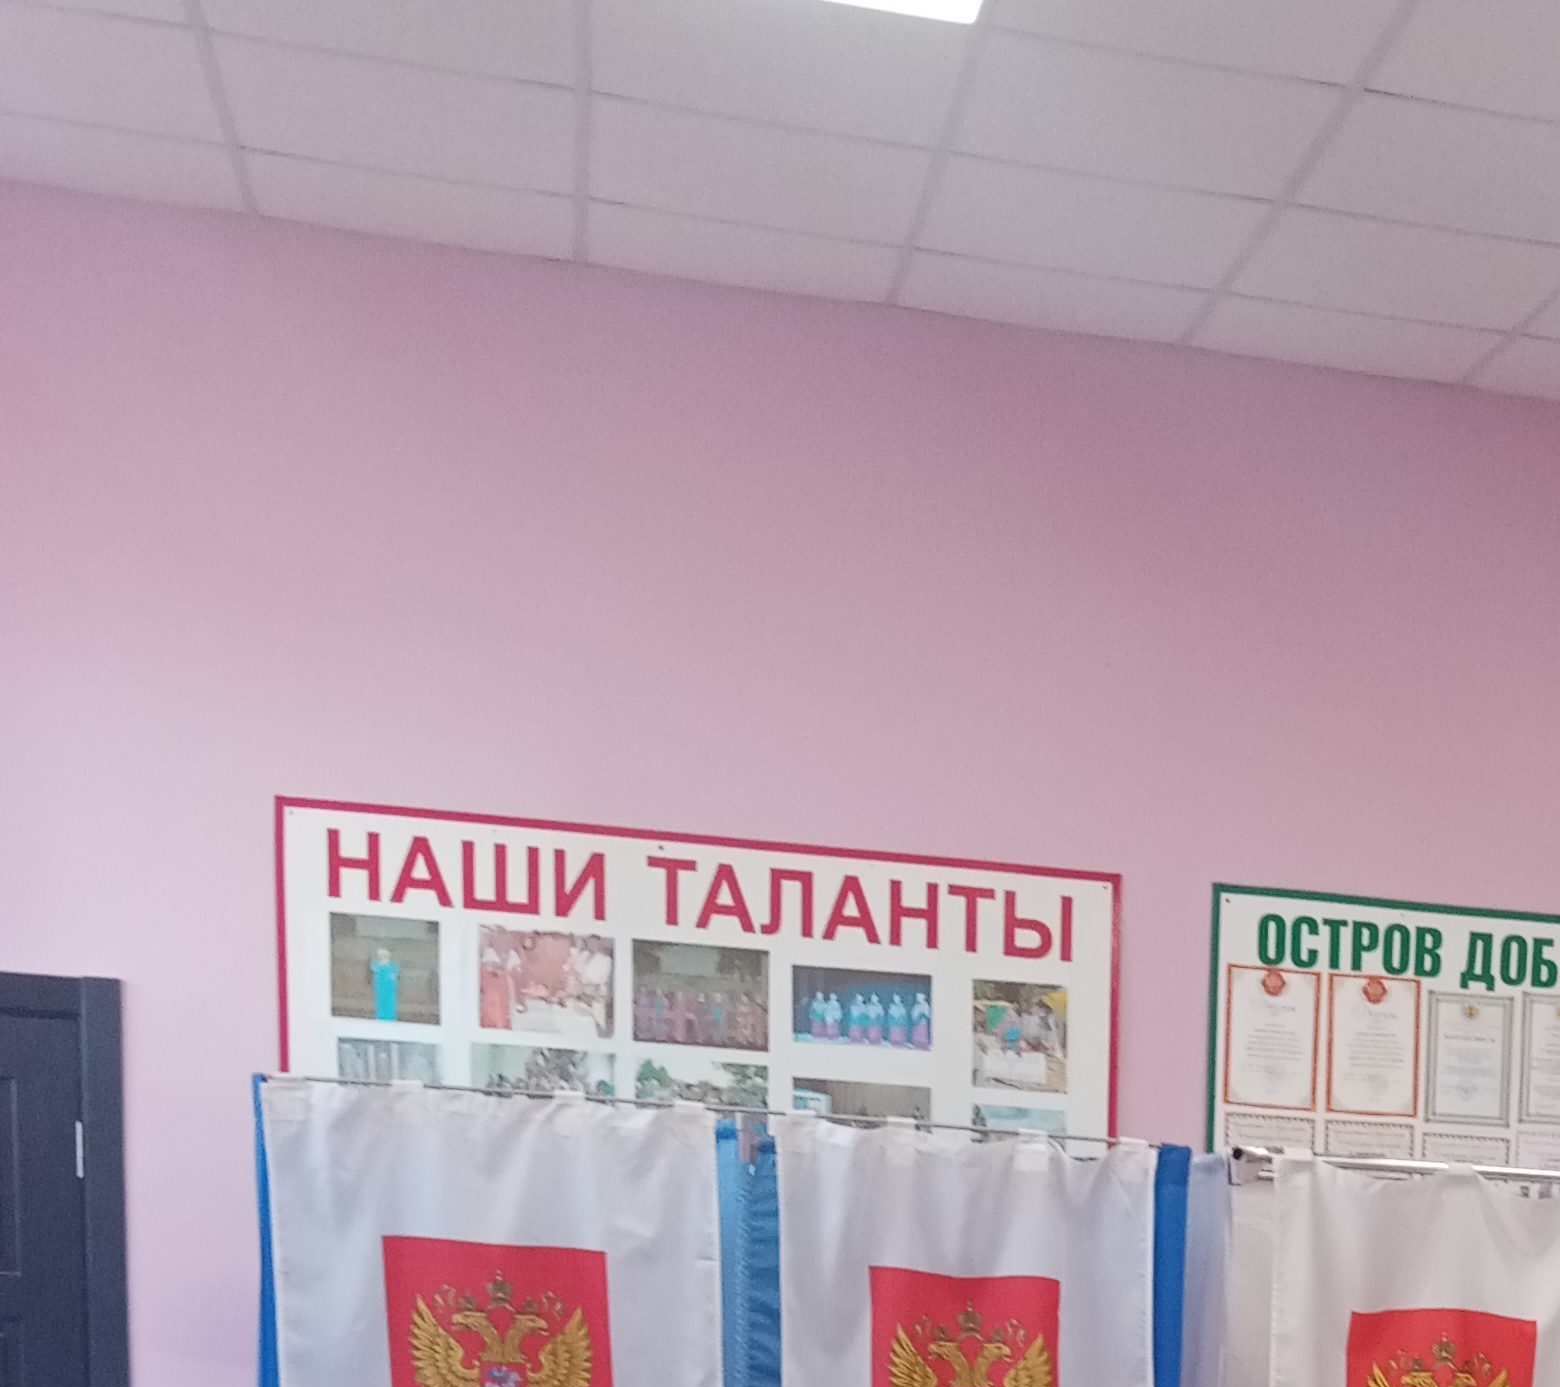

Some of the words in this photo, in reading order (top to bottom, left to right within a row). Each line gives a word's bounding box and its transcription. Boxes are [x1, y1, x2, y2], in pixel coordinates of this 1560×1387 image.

[326, 828, 607, 921] НАШИ
[647, 855, 1074, 962] ТАЛАНТЫ
[1257, 913, 1443, 978] ОСТРОВ
